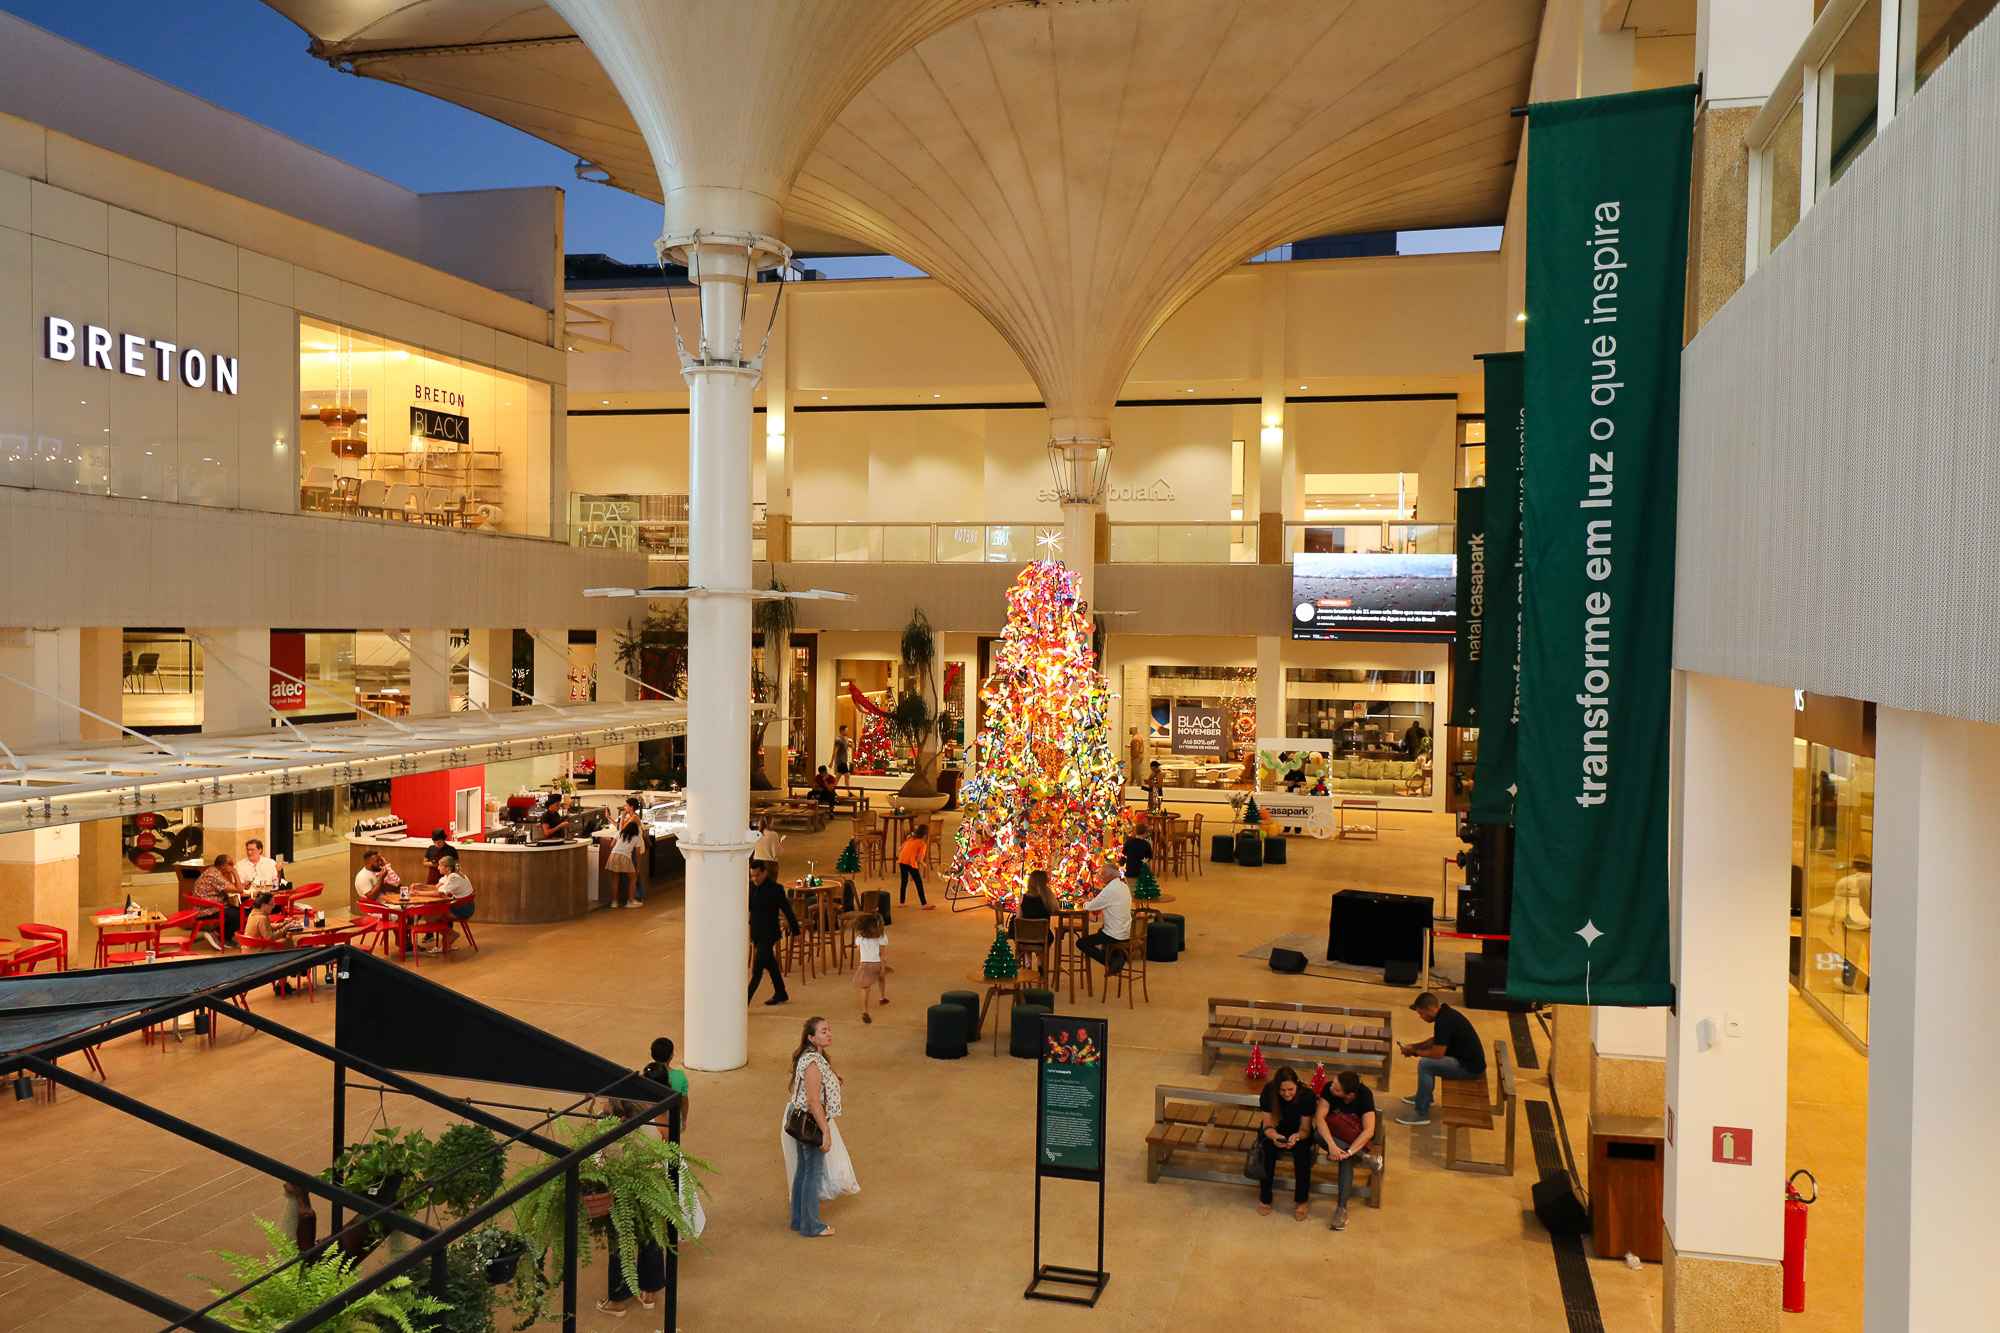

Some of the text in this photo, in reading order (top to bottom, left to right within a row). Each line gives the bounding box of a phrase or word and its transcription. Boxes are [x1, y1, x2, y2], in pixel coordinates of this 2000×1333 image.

[44, 316, 238, 395] BRETON
[415, 384, 464, 407] BRETON
[415, 411, 464, 440] BLACK
[1575, 201, 1627, 808] transforme em luz o que inspira
[1466, 532, 1485, 661] natal casapark
[271, 681, 303, 697] atec
[1177, 715, 1221, 728] BLACK
[1177, 728, 1222, 736] NOVEMBER
[1265, 807, 1309, 817] casapark
